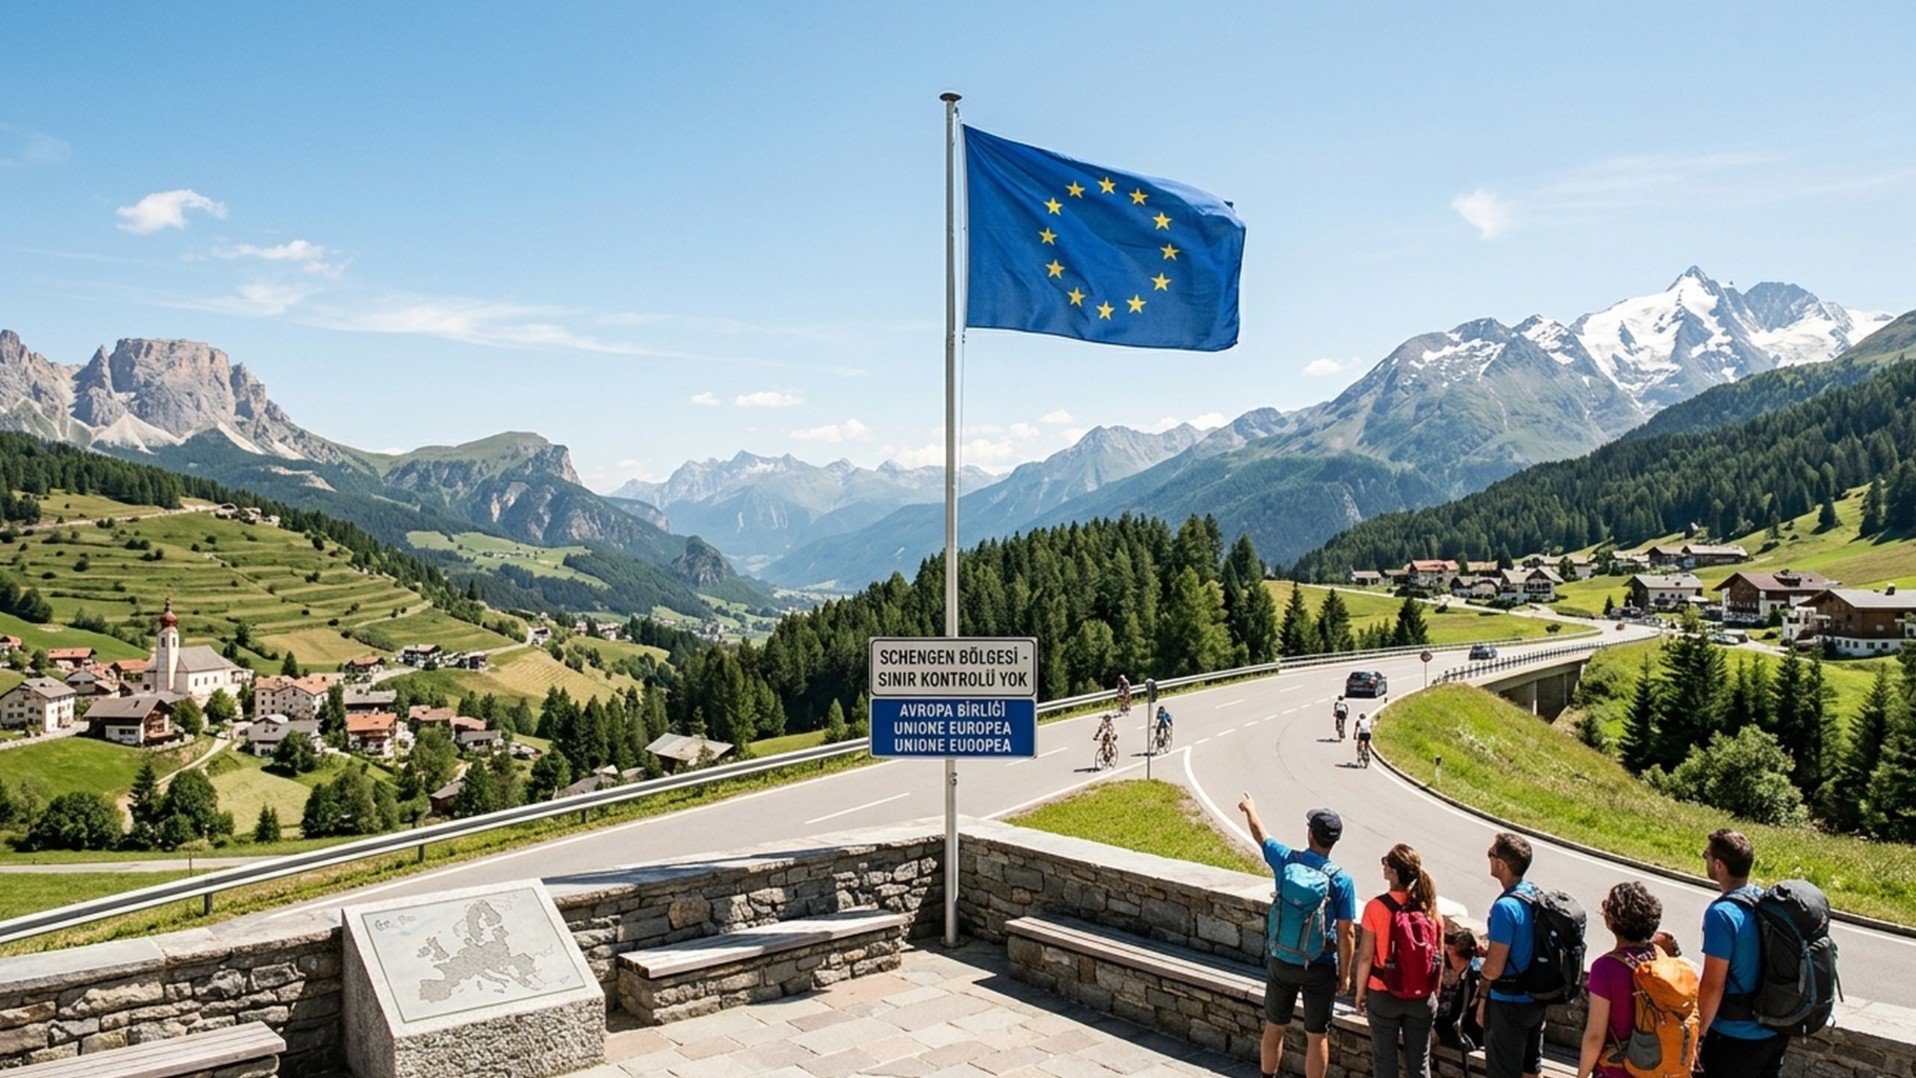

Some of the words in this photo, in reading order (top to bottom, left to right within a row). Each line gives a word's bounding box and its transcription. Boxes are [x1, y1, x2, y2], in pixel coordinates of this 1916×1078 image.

[880, 650, 954, 665] SCHENGEN
[959, 646, 1018, 665] BÖLGESİ
[878, 672, 916, 687] SINIR
[921, 668, 995, 687] KONTROLÜ
[999, 672, 1028, 687] YOK
[900, 703, 953, 717] AVROPA
[894, 721, 945, 735] UNIONE
[950, 721, 1012, 735] EUROPEA
[894, 738, 945, 752] UNIONE
